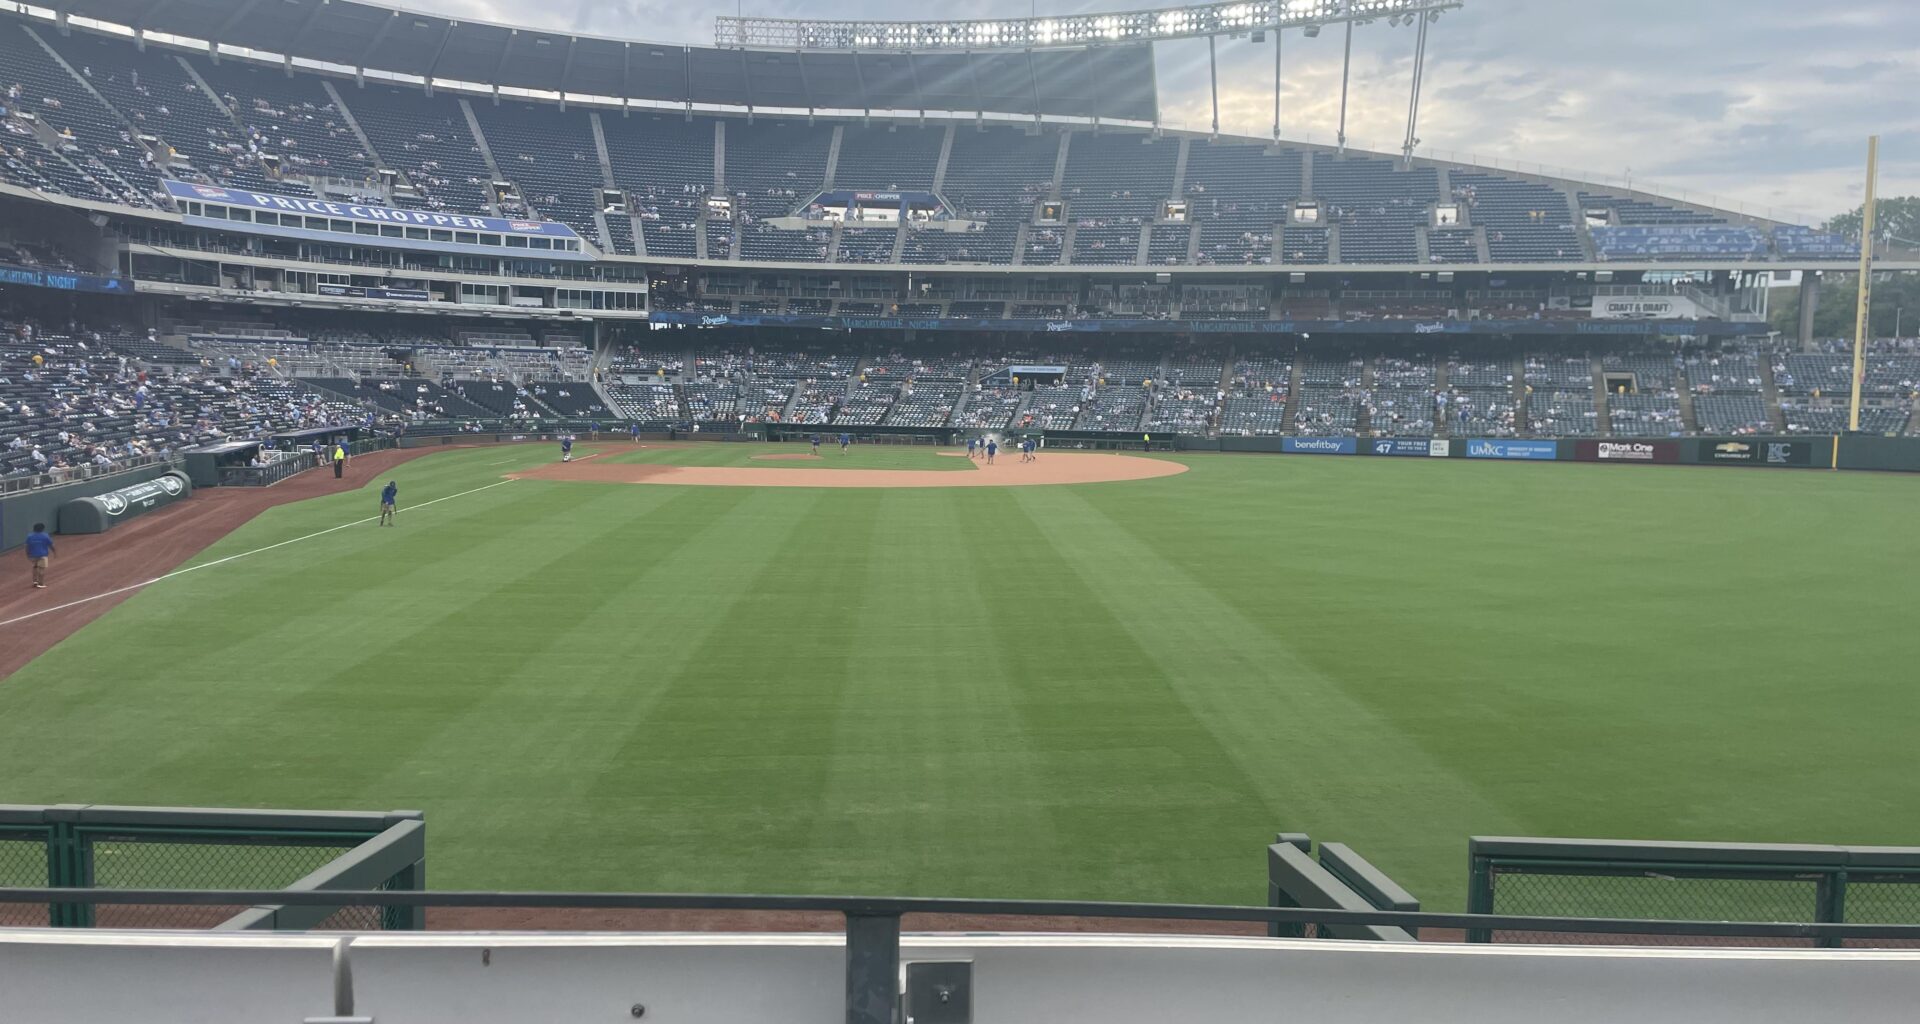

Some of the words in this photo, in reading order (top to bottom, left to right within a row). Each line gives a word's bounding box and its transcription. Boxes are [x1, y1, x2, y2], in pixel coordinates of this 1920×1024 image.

[251, 194, 344, 215] PRICE
[350, 206, 488, 229] CHOPPER
[47, 274, 78, 290] NIGHT
[1608, 303, 1633, 312] CRAFT
[1635, 303, 1641, 312] &
[1643, 303, 1669, 312] DRAFT
[701, 314, 727, 325] Royals
[909, 320, 939, 329] NIGHT
[1046, 320, 1073, 332] Royals
[1415, 321, 1444, 334] Royals
[1295, 439, 1341, 452] benefitbay
[1376, 443, 1391, 454] 47
[1470, 445, 1504, 456] UMKC
[1609, 442, 1632, 451] Mark
[1633, 442, 1654, 452] One
